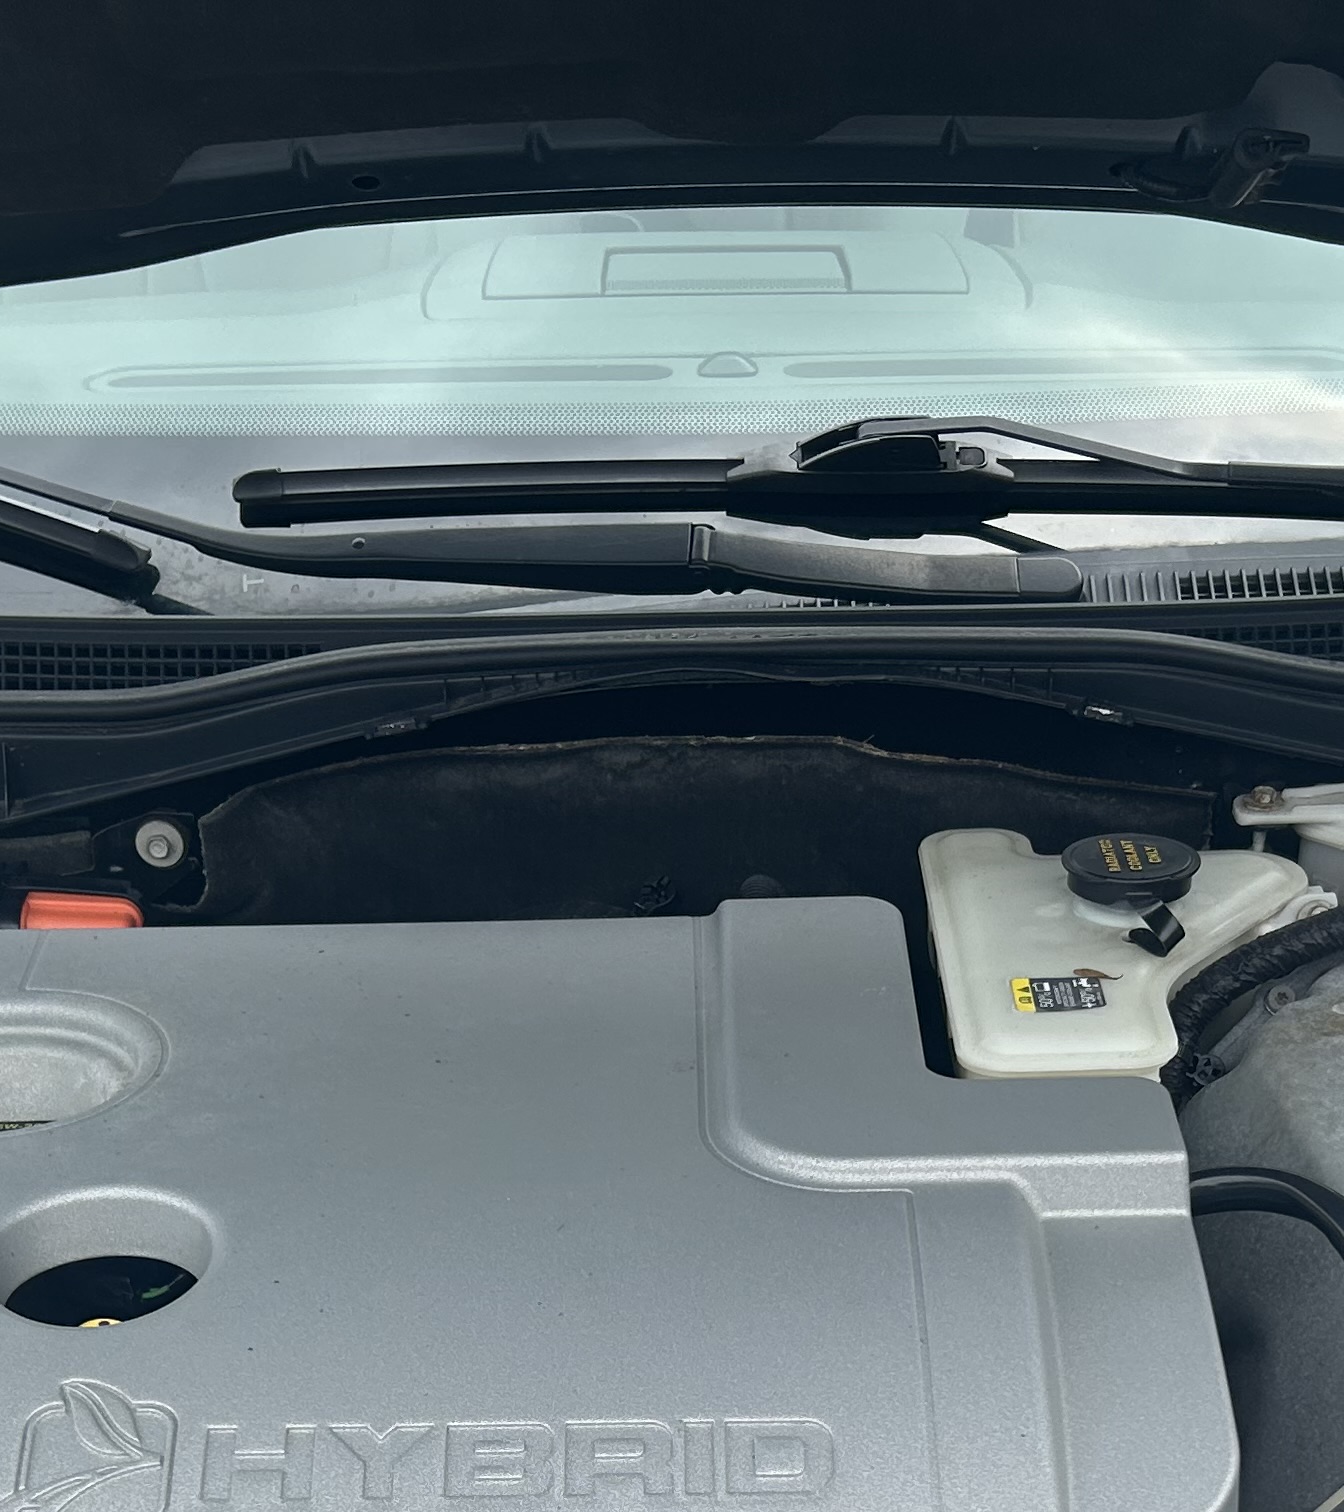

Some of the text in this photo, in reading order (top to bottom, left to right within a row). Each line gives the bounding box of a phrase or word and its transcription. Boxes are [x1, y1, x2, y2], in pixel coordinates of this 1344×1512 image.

[1119, 840, 1143, 871] COOLANT
[1143, 845, 1162, 863] ONLY
[199, 1417, 837, 1504] HYBRID
